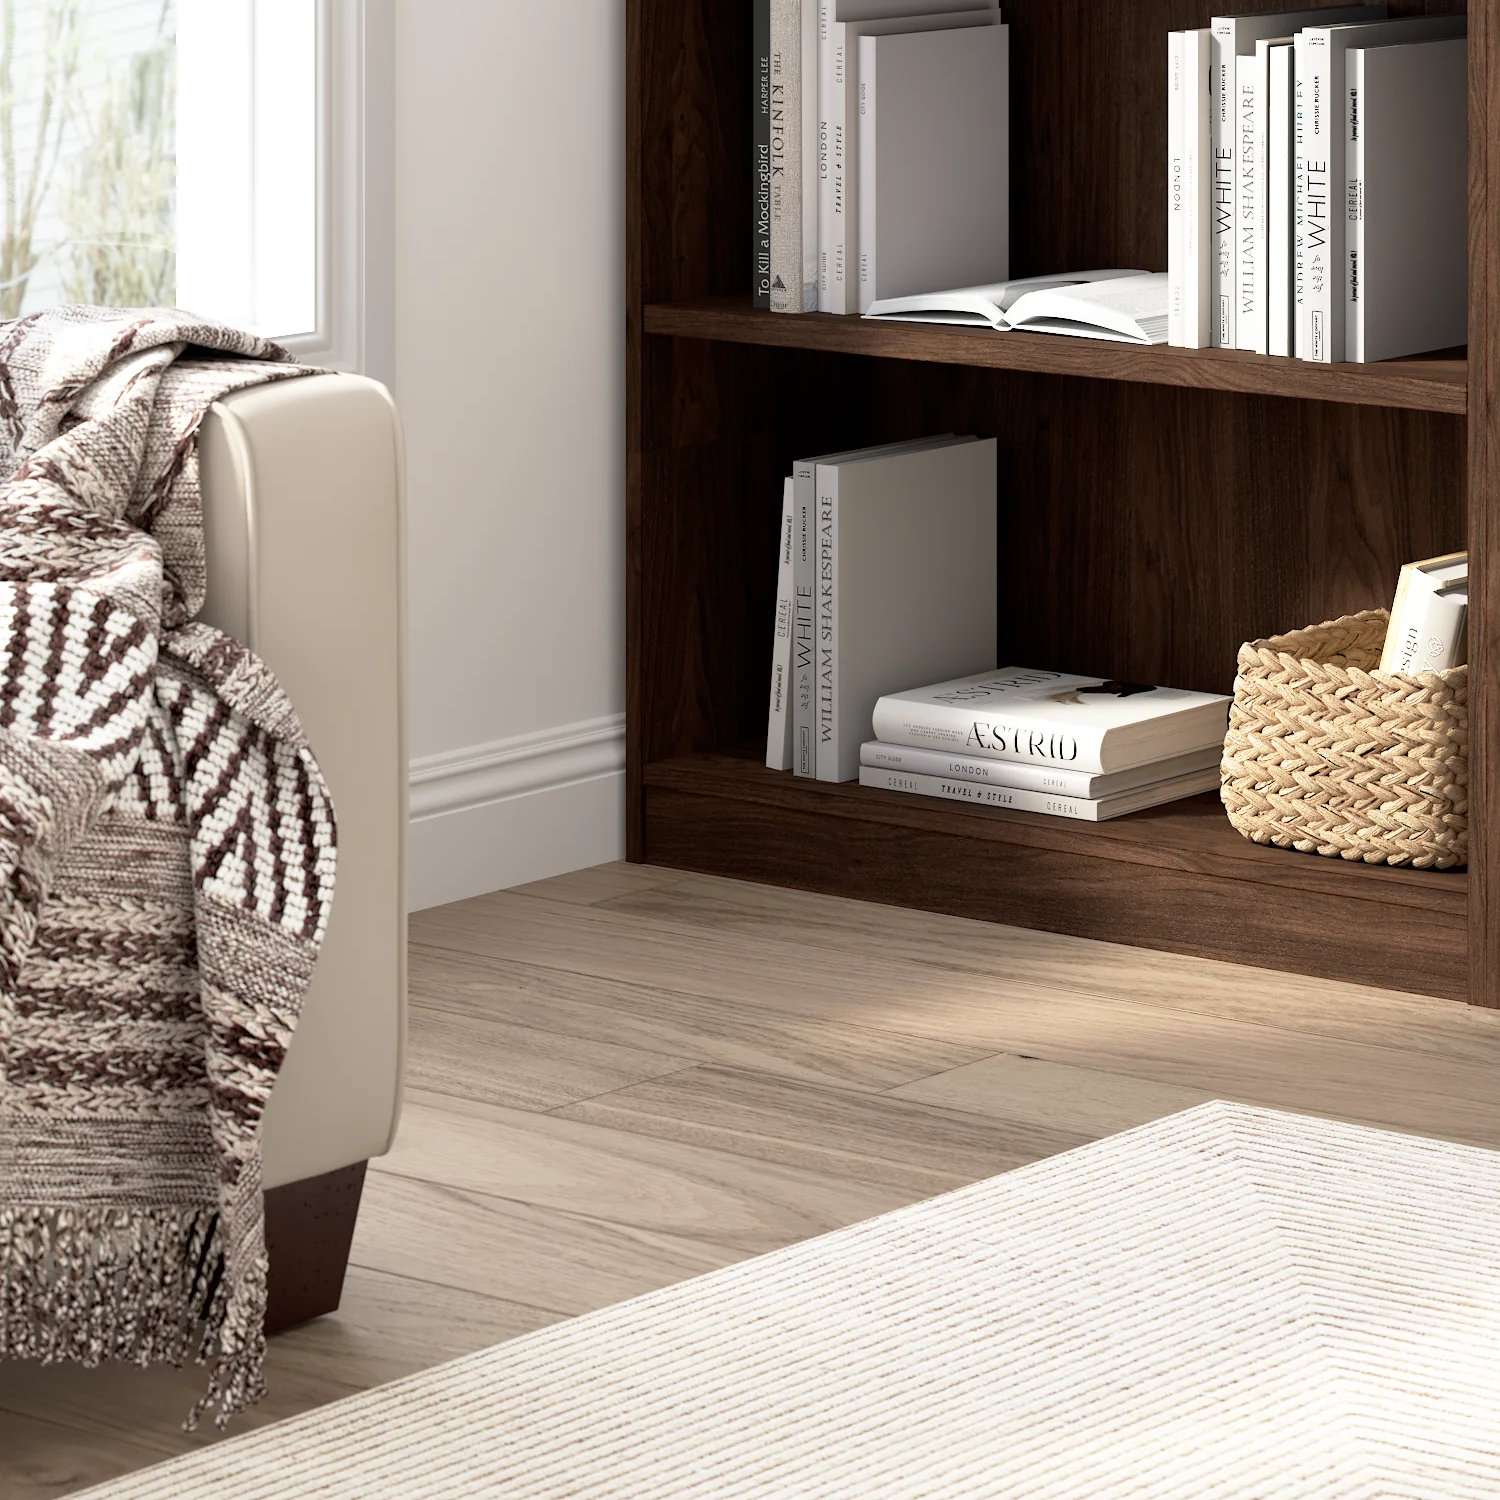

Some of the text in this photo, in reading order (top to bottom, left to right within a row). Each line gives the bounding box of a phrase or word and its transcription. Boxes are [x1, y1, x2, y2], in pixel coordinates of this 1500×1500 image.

[836, 46, 844, 84] CEREAL
[772, 52, 784, 220] THE KINFOLK TABLE
[820, 120, 828, 180] LONDON
[758, 144, 770, 296] To Kill a Mockingbird
[1216, 148, 1232, 234] WHITE
[1242, 84, 1254, 314] WILLIAM SHAKESPEARE
[1307, 160, 1326, 249] WHITE
[1348, 178, 1358, 220] CEREAL
[796, 584, 812, 668] WHITE
[821, 496, 832, 744] WILLIAM SHAKESPEARE
[949, 763, 990, 776] LONDON
[966, 722, 1078, 761] ÆSTRID
[887, 777, 918, 791] CEREAL
[1046, 801, 1078, 815] CEREAL
